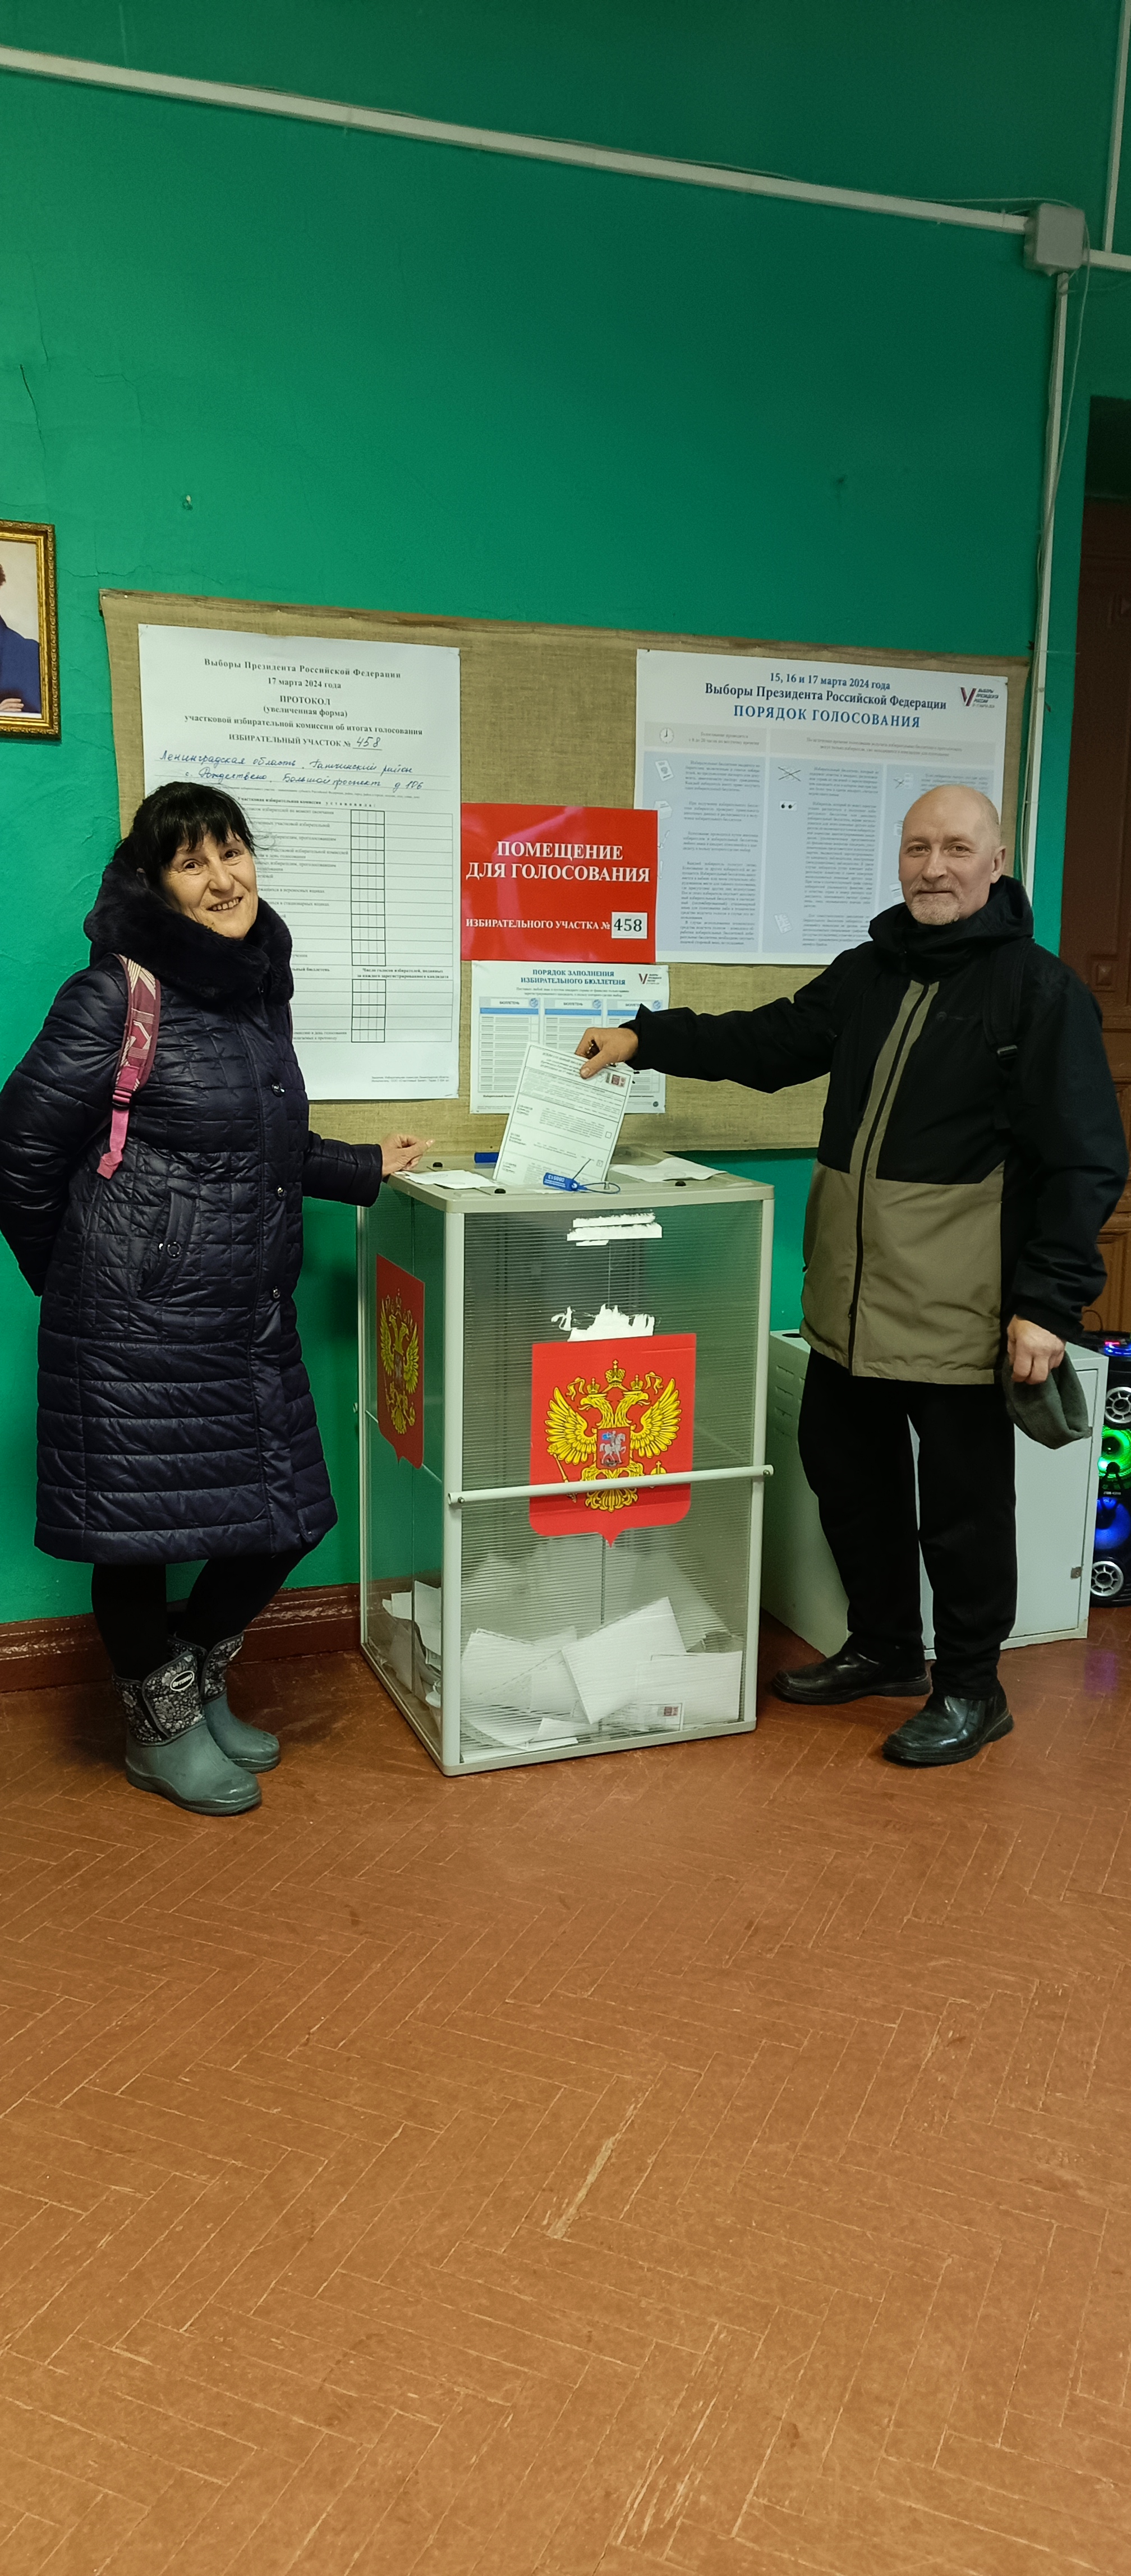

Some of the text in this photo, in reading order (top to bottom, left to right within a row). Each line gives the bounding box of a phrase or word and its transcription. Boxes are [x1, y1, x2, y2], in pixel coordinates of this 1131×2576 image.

[204, 658, 401, 678] Выборы Президента Российской Федерации
[305, 679, 322, 688] 2024
[770, 673, 783, 683] 15,
[786, 674, 797, 683] 16
[808, 675, 819, 684] 17
[820, 678, 847, 688] марта
[849, 678, 869, 688] 2024
[871, 681, 890, 691] года
[280, 695, 330, 706] ПРОТОКОЛ
[705, 683, 947, 711] Выборы Президента Российской Федерации
[264, 706, 348, 718] (увеличенная форма)
[734, 705, 921, 728] ПОРЯДОК ГОЛОСОВАНИЯ
[185, 715, 232, 724] участковой
[234, 717, 293, 728] избирательной
[296, 722, 334, 731] комиссии
[375, 727, 422, 735] голосования
[229, 733, 301, 744] ИЗБИРАТЕЛЬНЫЙ
[303, 738, 341, 747] УЧАСТОК
[356, 737, 381, 748] 458
[160, 750, 246, 769] Ленинградская
[497, 841, 623, 861] ПОМЕЩЕНИЕ
[466, 862, 650, 882] ДЛЯ ГОЛОСОВАНИЯ
[466, 918, 642, 932] ИЗБИРАТЕЛЬНОГО УЧАСТКА № 458
